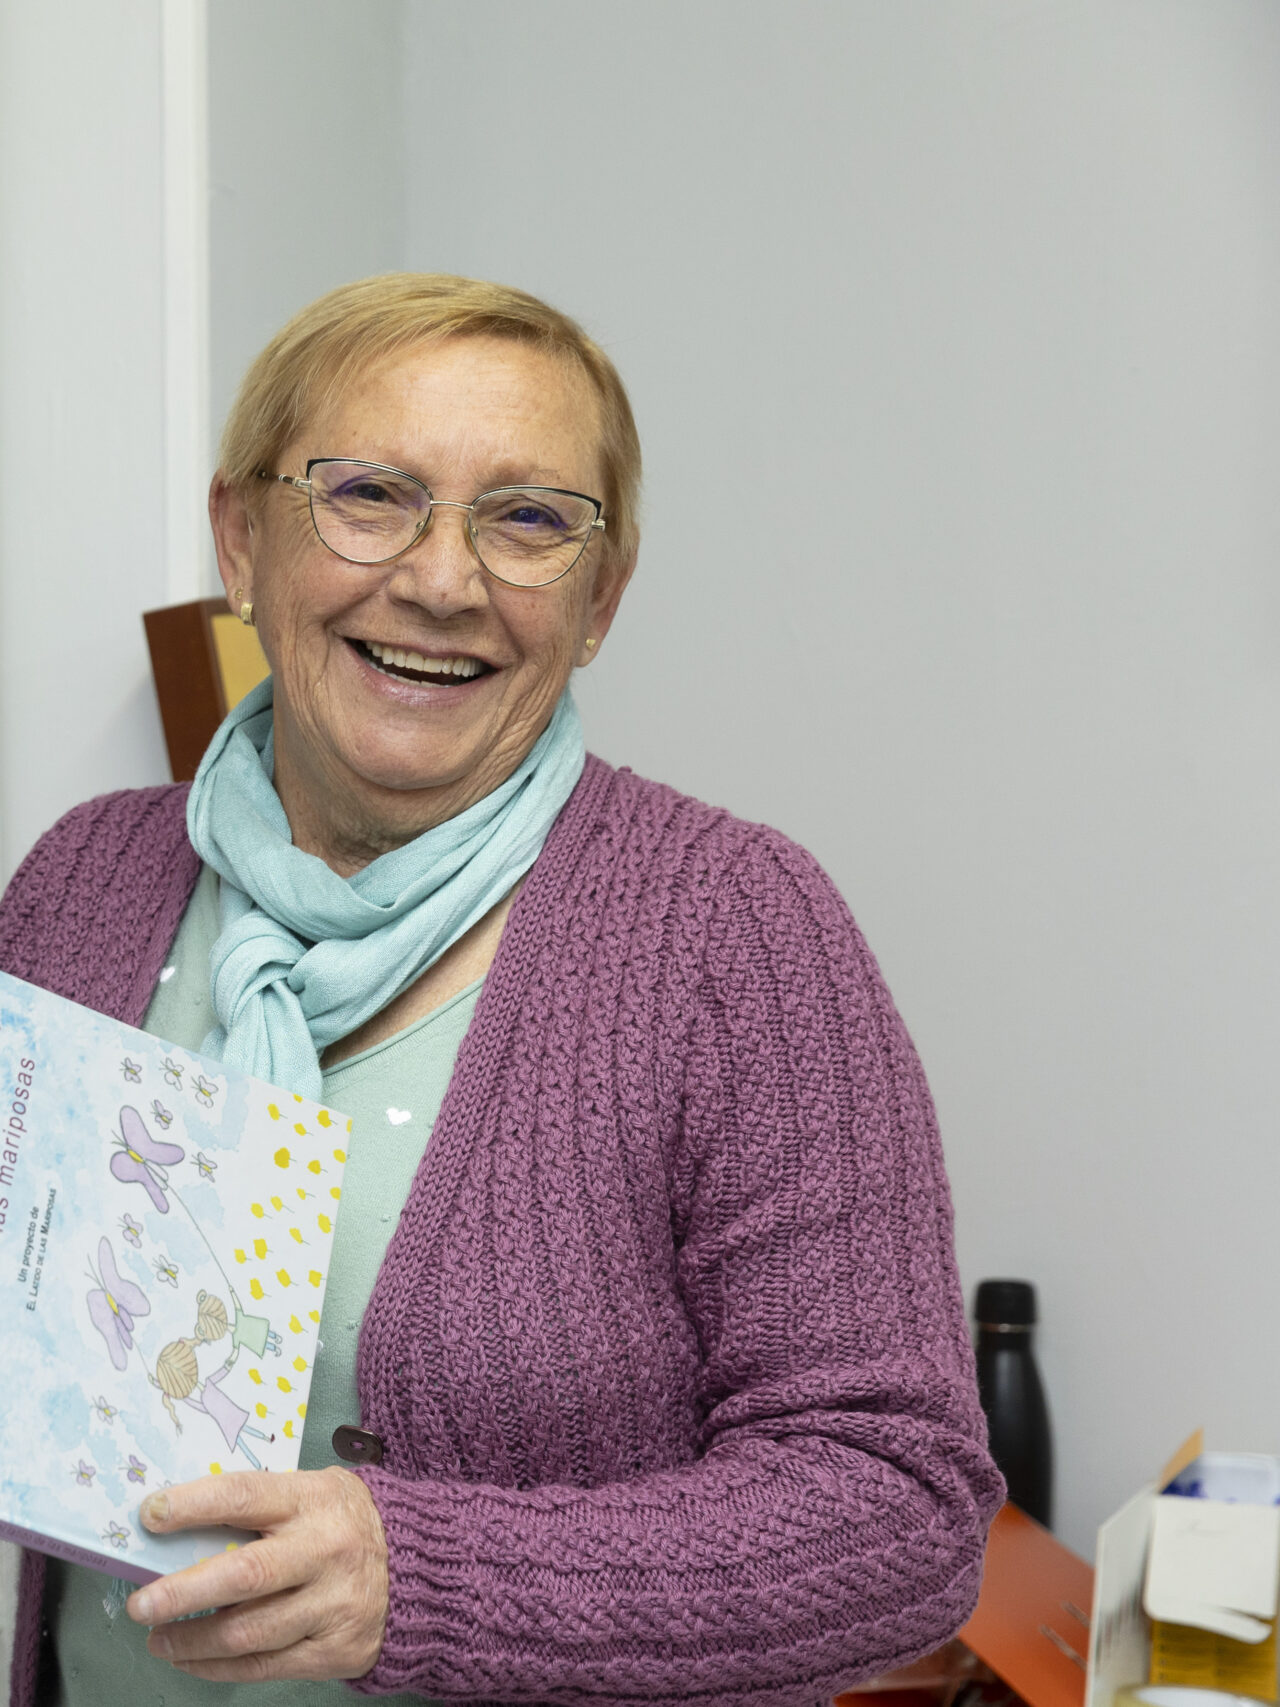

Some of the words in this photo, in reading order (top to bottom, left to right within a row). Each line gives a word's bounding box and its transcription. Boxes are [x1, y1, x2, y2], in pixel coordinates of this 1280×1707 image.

[17, 1268, 27, 1282] Un
[22, 1221, 37, 1267] proyecto
[30, 1206, 39, 1219] de
